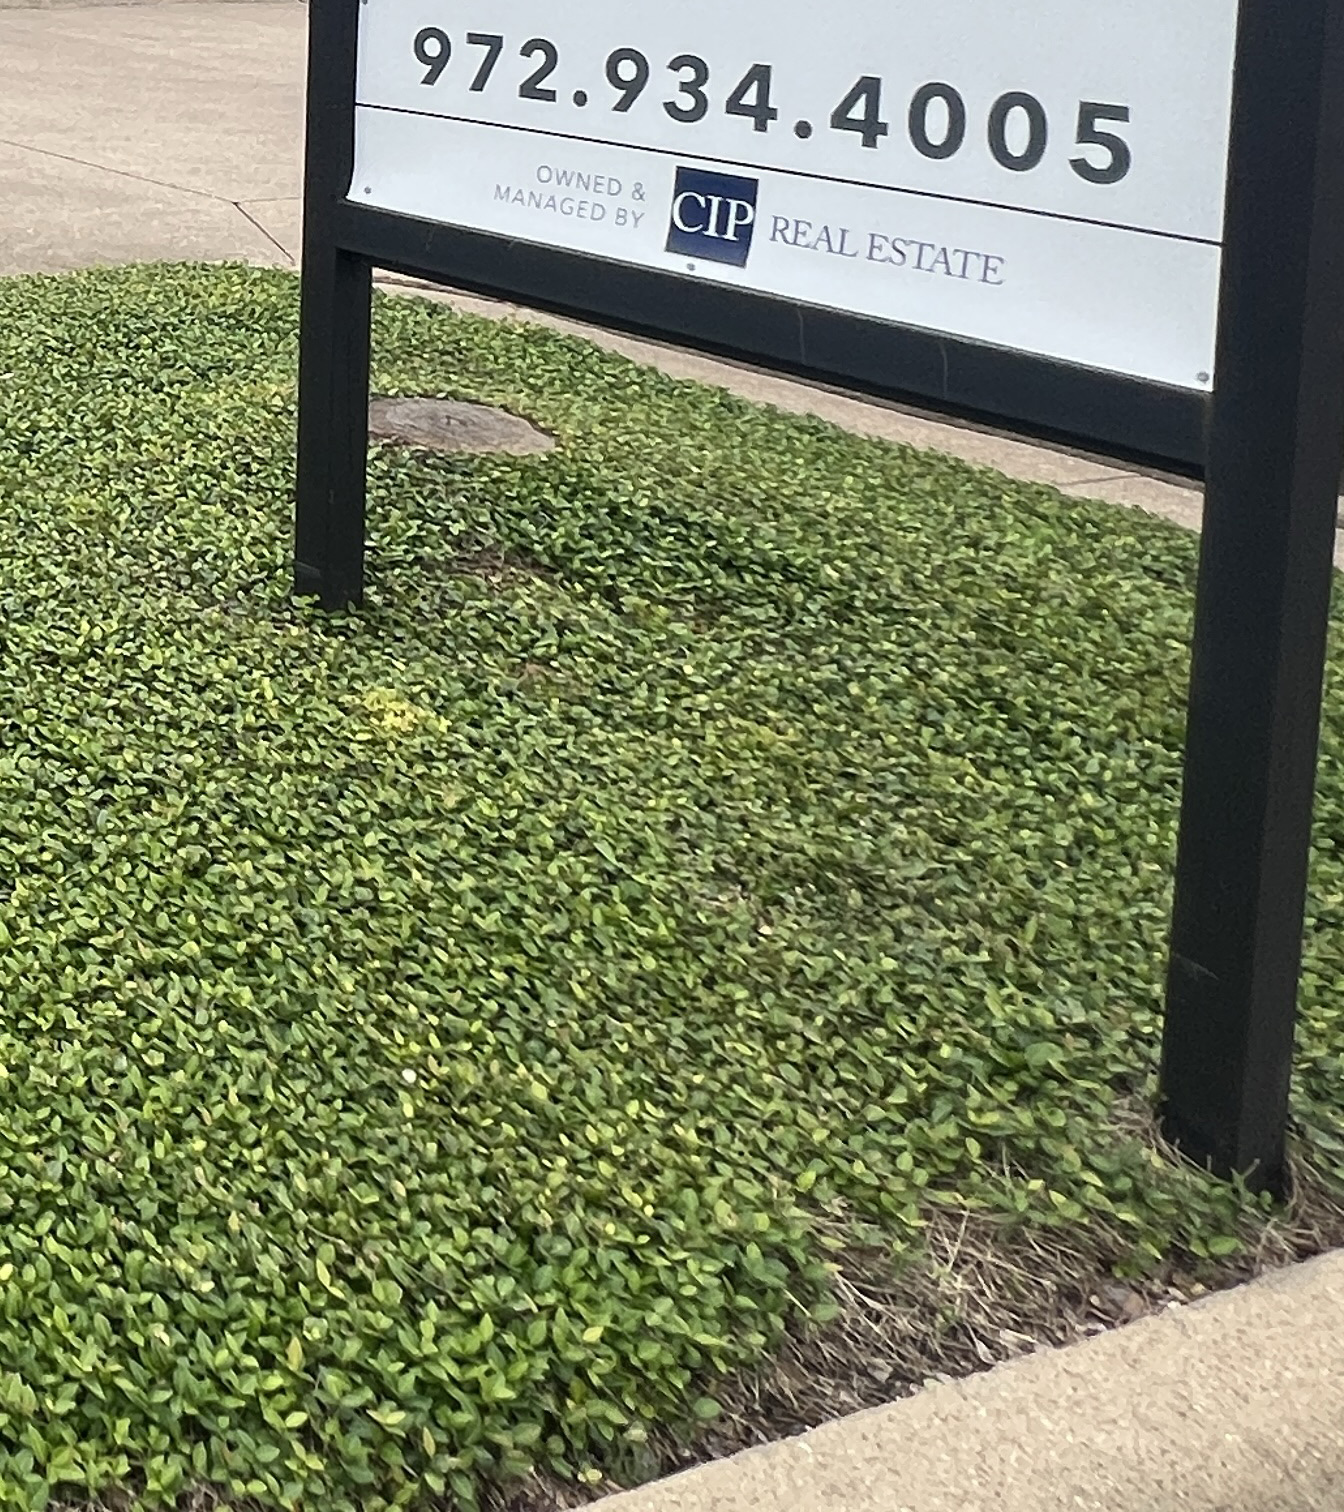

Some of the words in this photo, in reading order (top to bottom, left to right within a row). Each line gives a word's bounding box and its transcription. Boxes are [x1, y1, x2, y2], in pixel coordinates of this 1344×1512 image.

[412, 26, 1133, 186] 972.934.4005
[493, 184, 607, 225] MANAGED
[615, 208, 646, 230] BY
[535, 164, 623, 198] OWNED
[631, 182, 647, 202] &
[671, 190, 755, 243] CIP
[769, 214, 860, 259] REAL
[866, 233, 1007, 286] ESTATE
